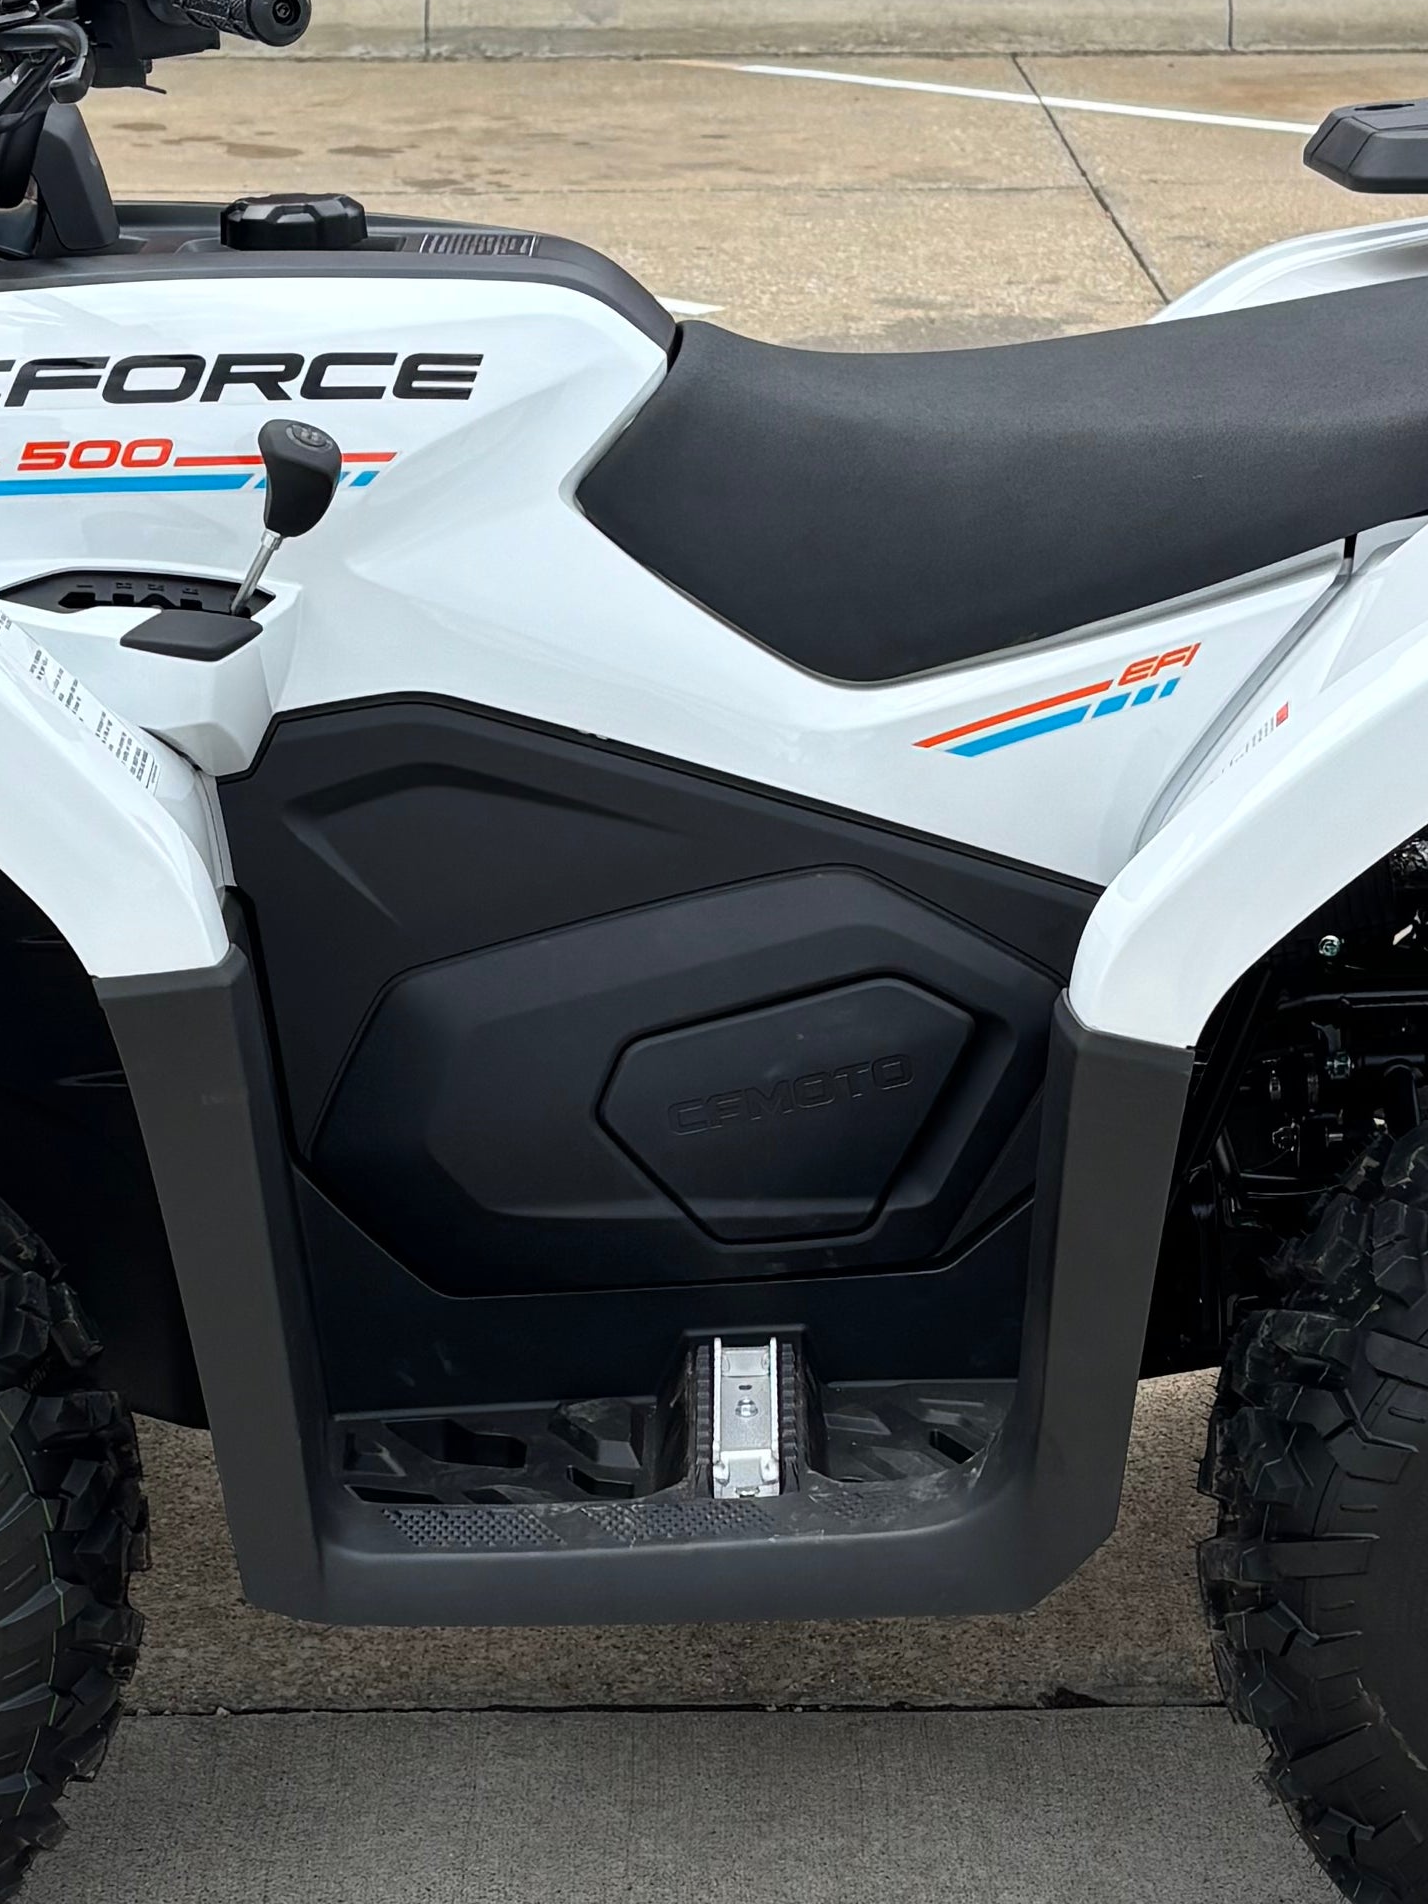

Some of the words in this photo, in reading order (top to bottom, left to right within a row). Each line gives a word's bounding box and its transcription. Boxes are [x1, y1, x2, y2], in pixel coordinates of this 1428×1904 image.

[16, 437, 174, 472] 500
[1118, 641, 1202, 687] EFI
[667, 1052, 917, 1137] CFMOTO
